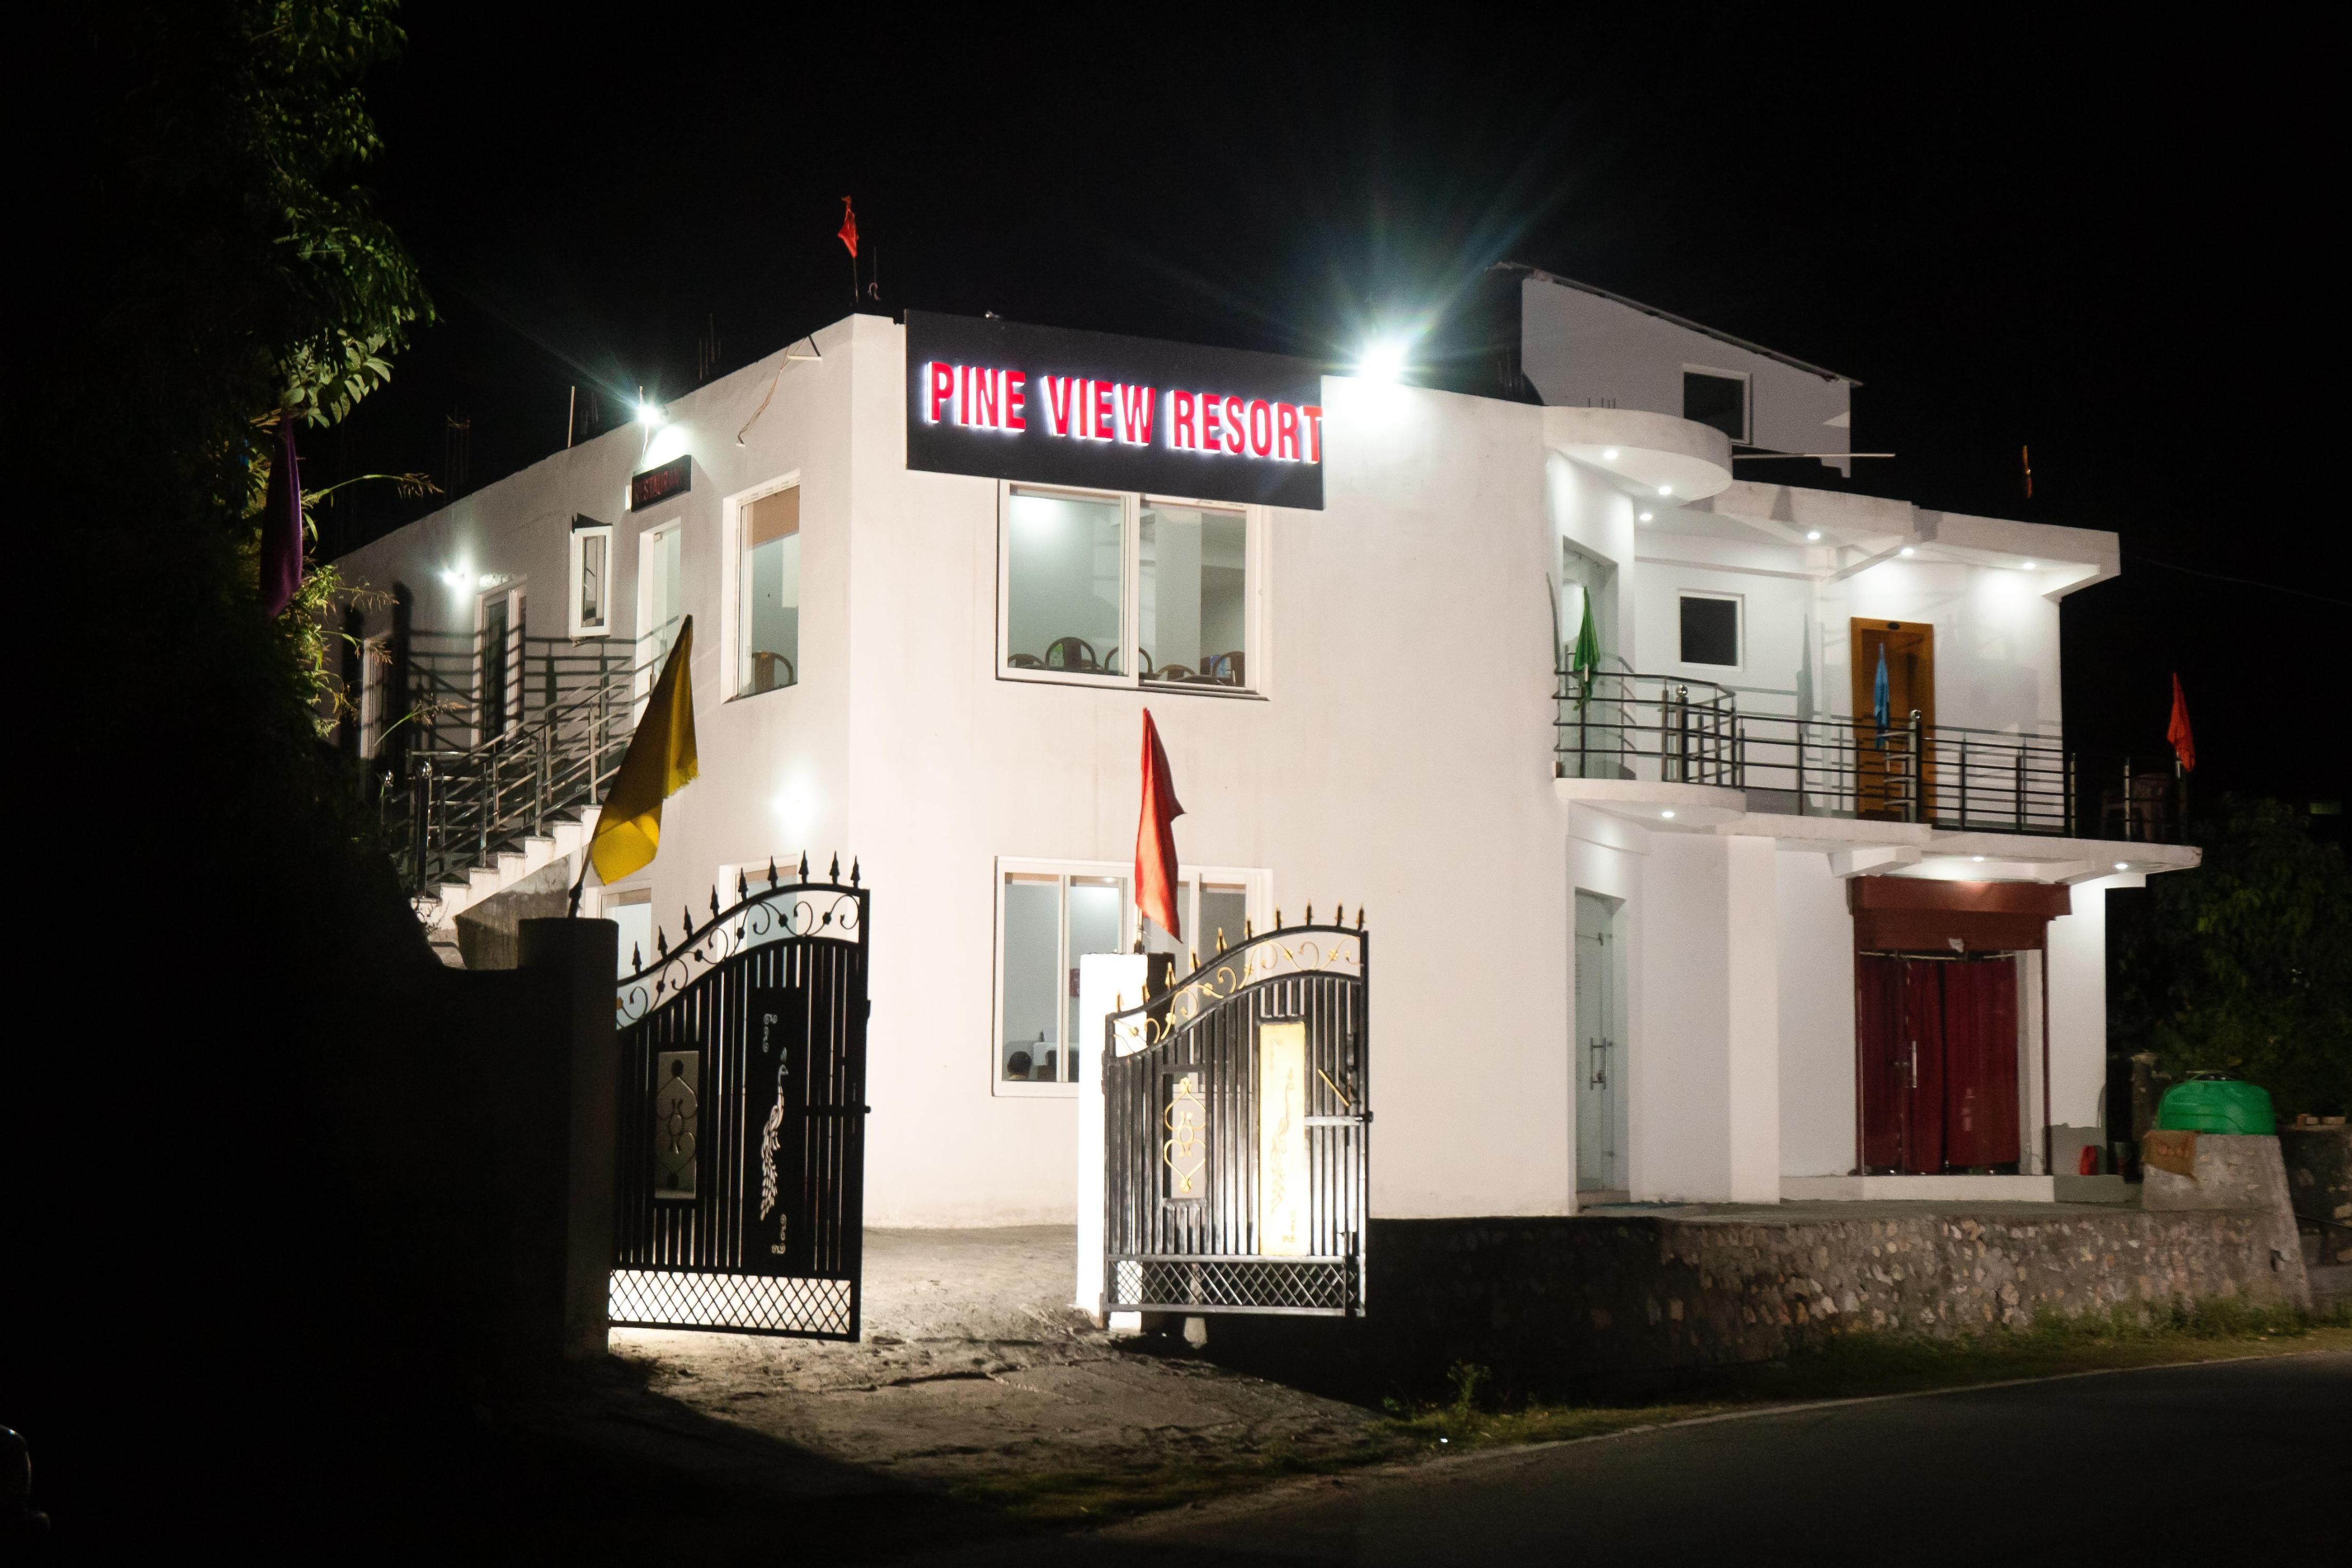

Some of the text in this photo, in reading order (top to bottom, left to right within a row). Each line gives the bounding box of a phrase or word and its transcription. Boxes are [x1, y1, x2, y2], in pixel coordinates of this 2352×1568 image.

[926, 361, 1323, 464] PINE VIEW RESORT
